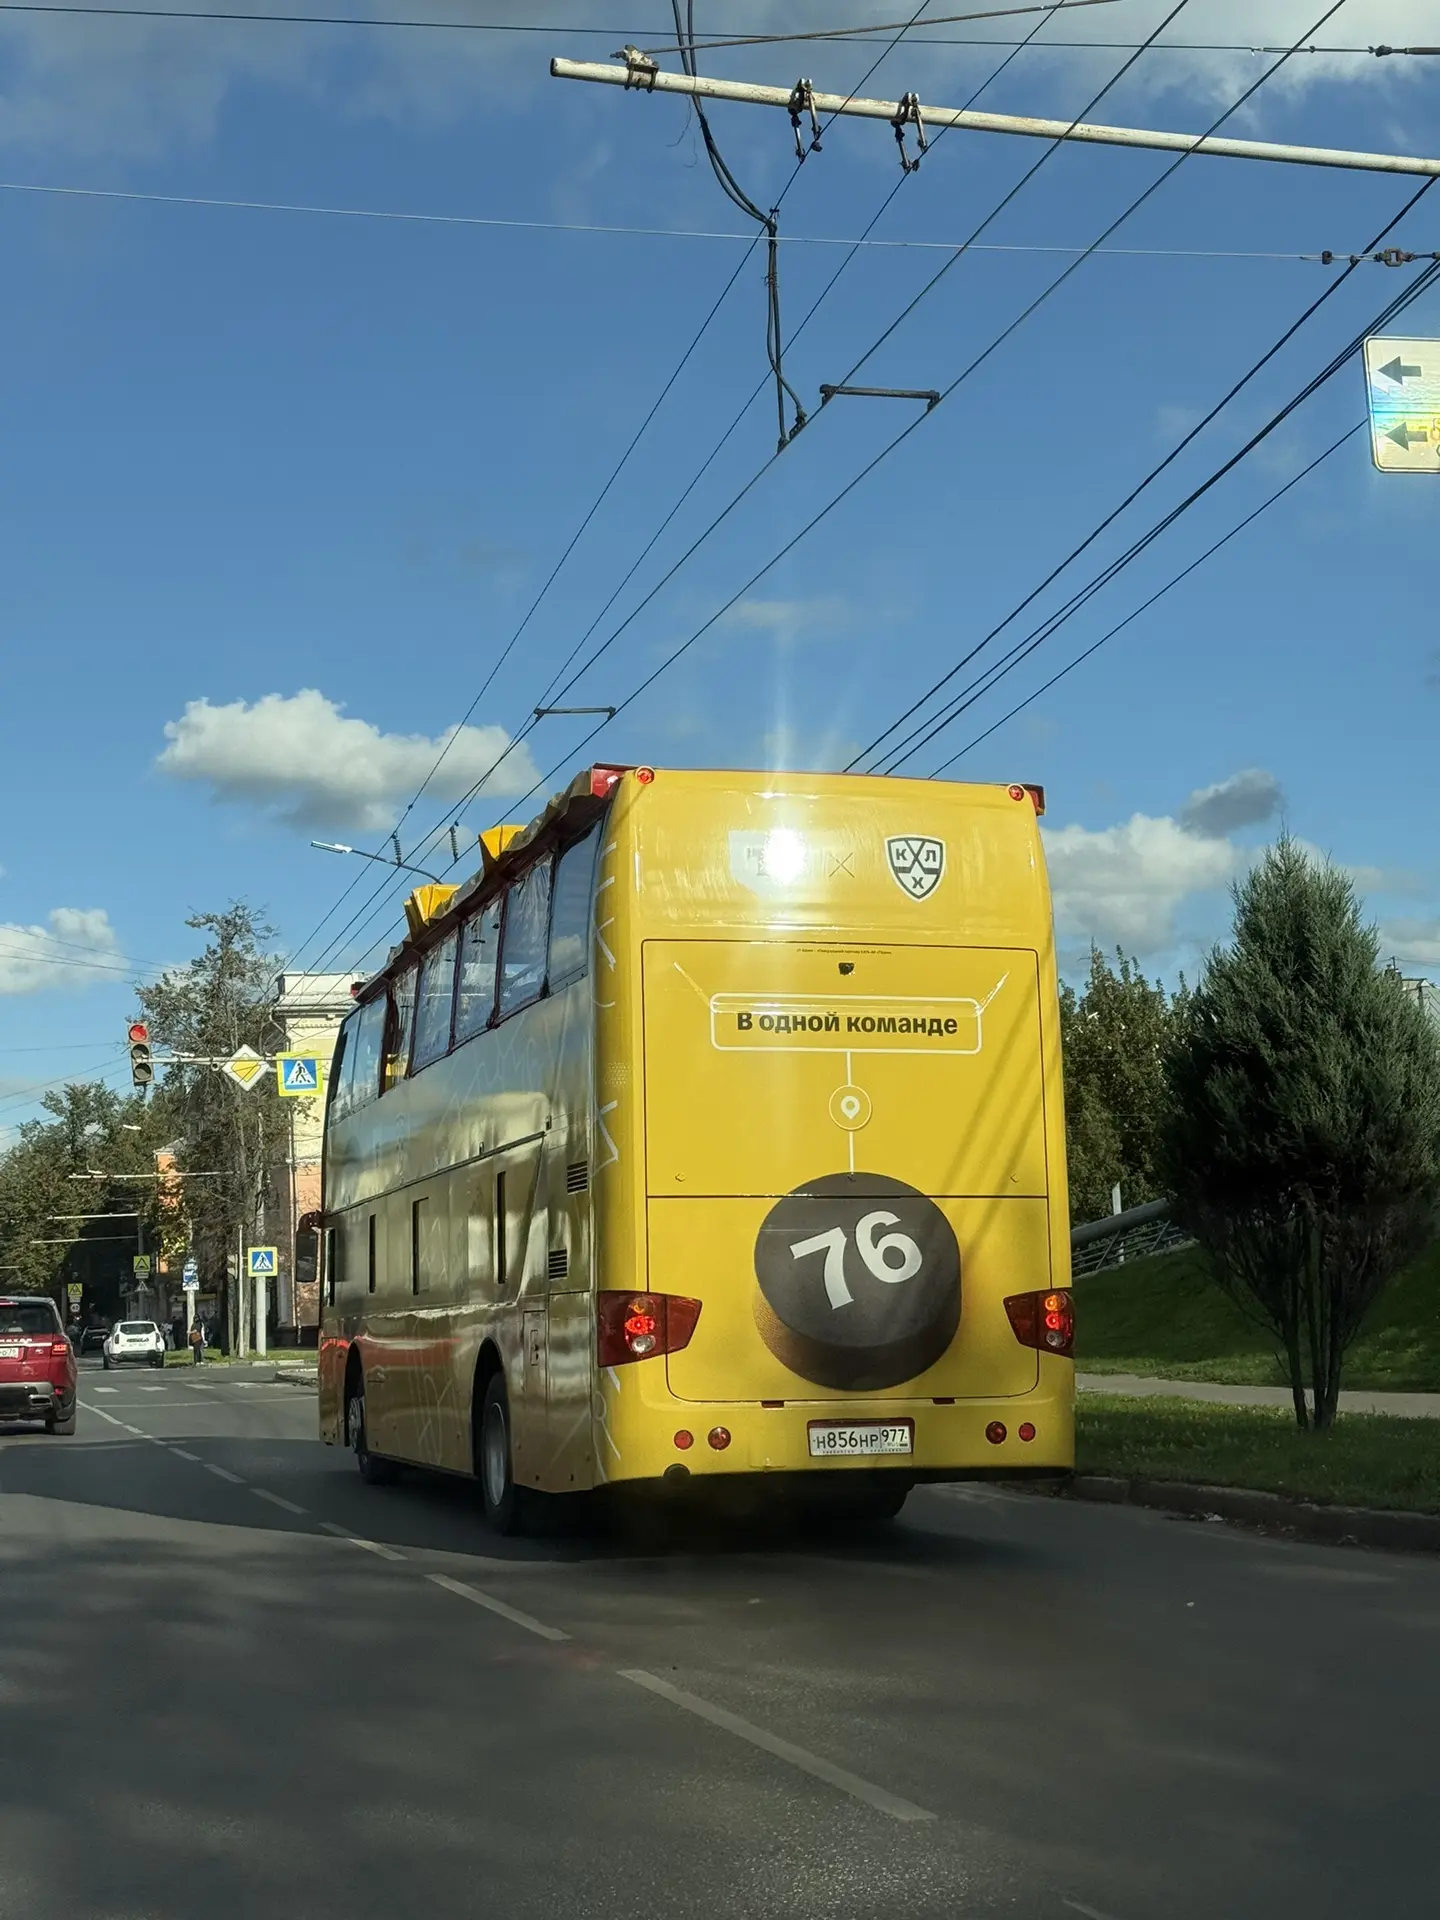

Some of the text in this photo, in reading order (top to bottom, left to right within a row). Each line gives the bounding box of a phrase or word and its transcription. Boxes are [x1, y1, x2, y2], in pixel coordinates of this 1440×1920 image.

[737, 1011, 958, 1036] В одной команде
[789, 1210, 923, 1310] 76
[881, 1428, 906, 1442] 977
